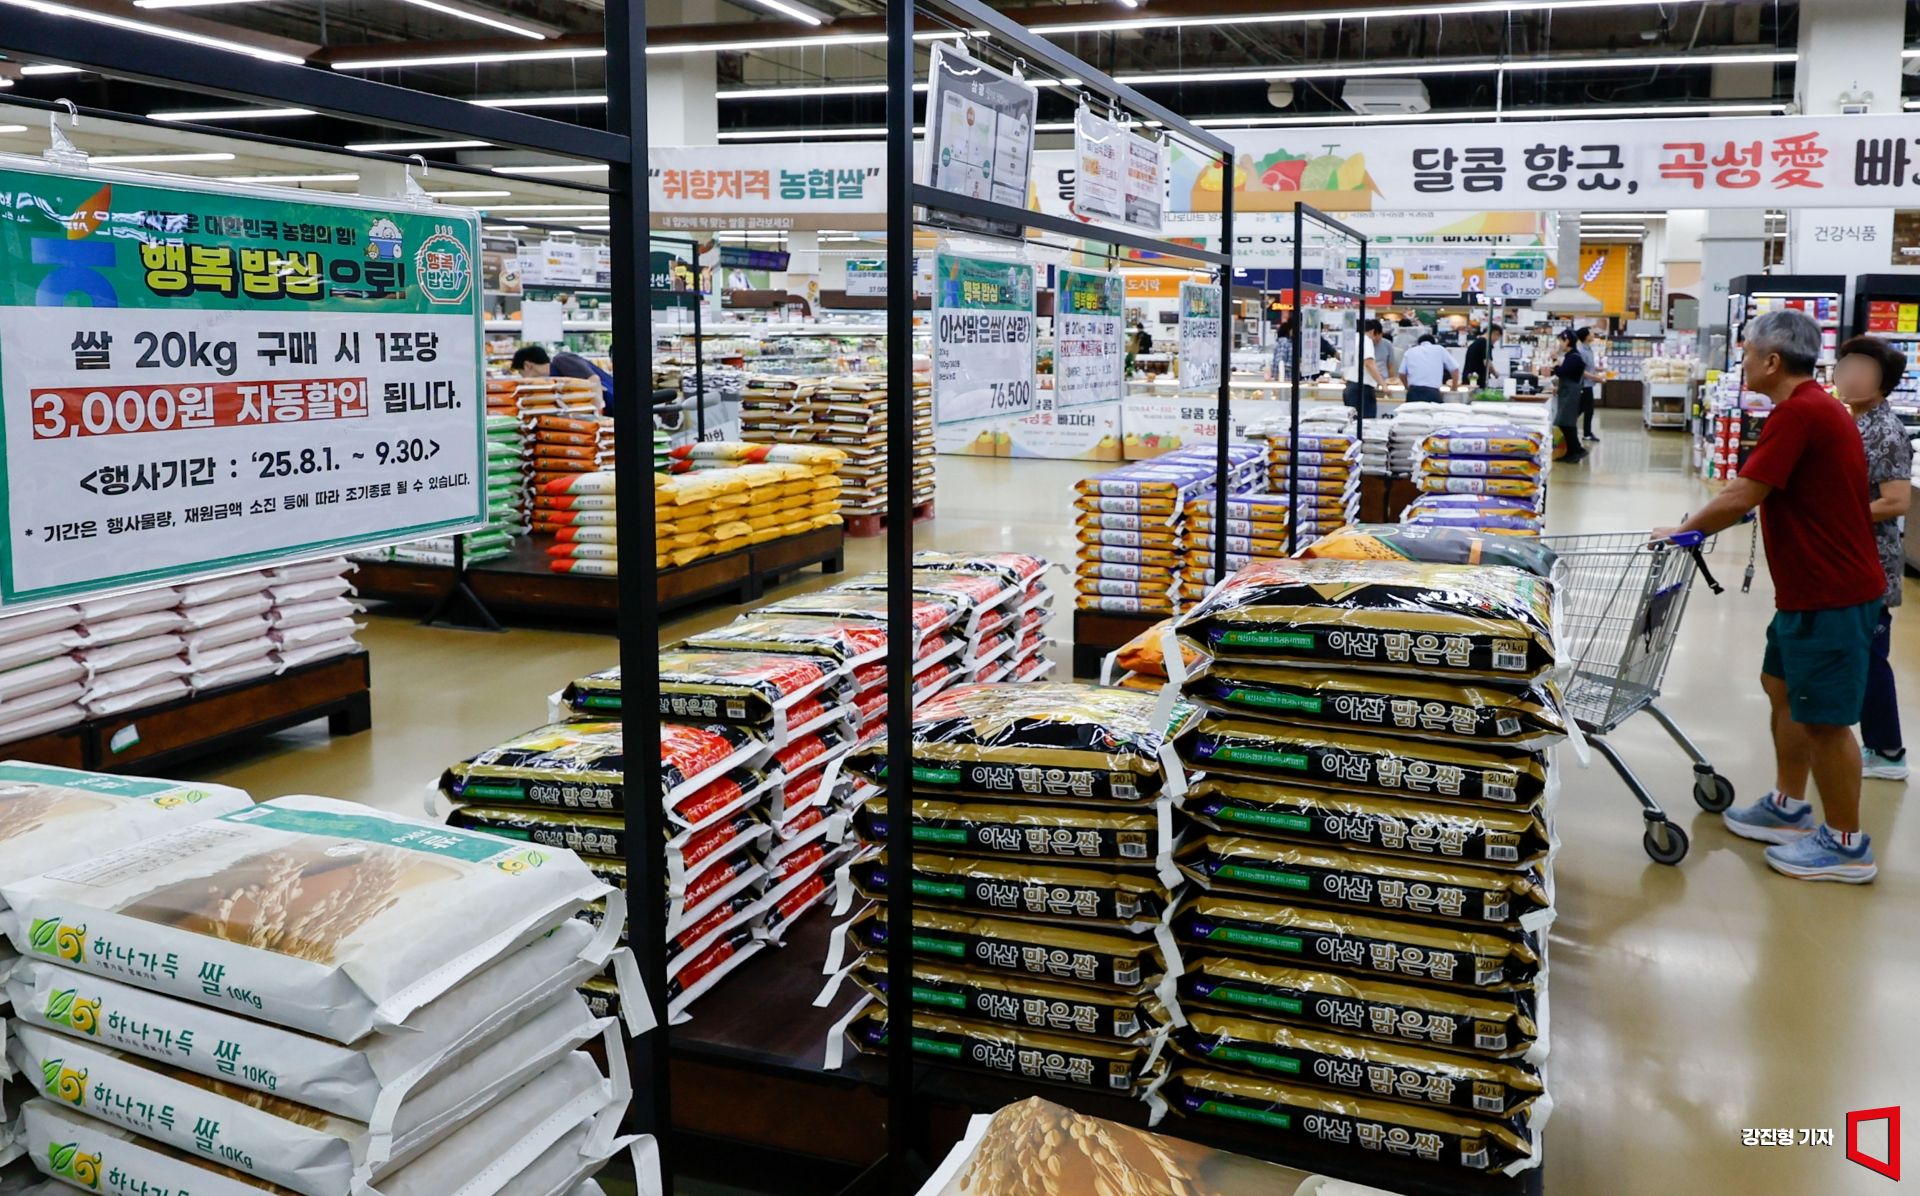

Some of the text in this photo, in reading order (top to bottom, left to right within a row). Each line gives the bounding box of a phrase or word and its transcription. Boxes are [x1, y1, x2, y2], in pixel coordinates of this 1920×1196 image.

[1412, 131, 1920, 195] 달콤 향긋, 곡성愛 빠
[204, 214, 278, 242] 대한민국
[282, 221, 332, 244] 농협의
[336, 227, 356, 246] 힘!
[1814, 225, 1878, 243] 건강식품
[427, 252, 456, 272] 행복
[427, 271, 454, 291] 밥심
[1127, 279, 1161, 292] 도시락
[940, 314, 1031, 344] 아산맑은쌀(삼광)
[71, 331, 439, 376] 쌀 20kg 구매 시 1포당
[33, 380, 461, 438] 3,000원 자동할인 됩니다.
[989, 380, 1030, 409] 76,500
[1057, 413, 1096, 427] 빠지다!
[80, 456, 216, 496] <행사기간
[375, 438, 441, 466] 9.30.>
[43, 520, 97, 543] 기간은
[106, 511, 176, 535] 행사물량,
[184, 501, 242, 524] 재원금액
[249, 497, 276, 515] 소진
[283, 493, 309, 511] 등에
[315, 489, 340, 506] 따라
[345, 483, 392, 502] 조기종료
[412, 478, 424, 493] 수
[428, 472, 471, 490] 있습니다.
[1328, 631, 1377, 658] 아산
[1383, 632, 1475, 667] 맑은쌀
[1335, 695, 1385, 723] 아산
[1391, 699, 1480, 735] 맑은쌀
[971, 766, 1015, 791] 아산
[1018, 767, 1095, 797] 맑은쌀
[1321, 753, 1371, 783] 아산
[1376, 758, 1466, 796] 맑은쌀
[529, 786, 561, 805] 아산
[978, 827, 1021, 850] 아산
[1025, 828, 1102, 857] 맑은쌀
[1324, 815, 1374, 840] 아산
[1379, 820, 1468, 856] 맑은쌀
[976, 882, 1100, 917] 아산 맑은쌀
[1323, 874, 1372, 903] 아산
[1377, 880, 1467, 917] 맑은쌀
[93, 936, 263, 1010] 하나가득 쌀 10Kg
[975, 941, 1099, 980] 아산 맑은쌀
[1316, 937, 1365, 965] 아산
[1370, 943, 1459, 981] 맑은쌀
[976, 993, 1099, 1033] 아산 맑은쌀
[1315, 999, 1364, 1026] 아산
[1369, 1006, 1458, 1044] 맑은쌀
[108, 1010, 278, 1091] 하나가득 쌀 10Kg
[972, 1043, 1095, 1085] 아산 맑은쌀
[1313, 1058, 1363, 1087] 아산
[1367, 1066, 1456, 1105] 맑은쌀
[93, 1082, 254, 1169] 하나가득 쌀 10Kg
[1303, 1115, 1446, 1161] 아산 맑은쌀
